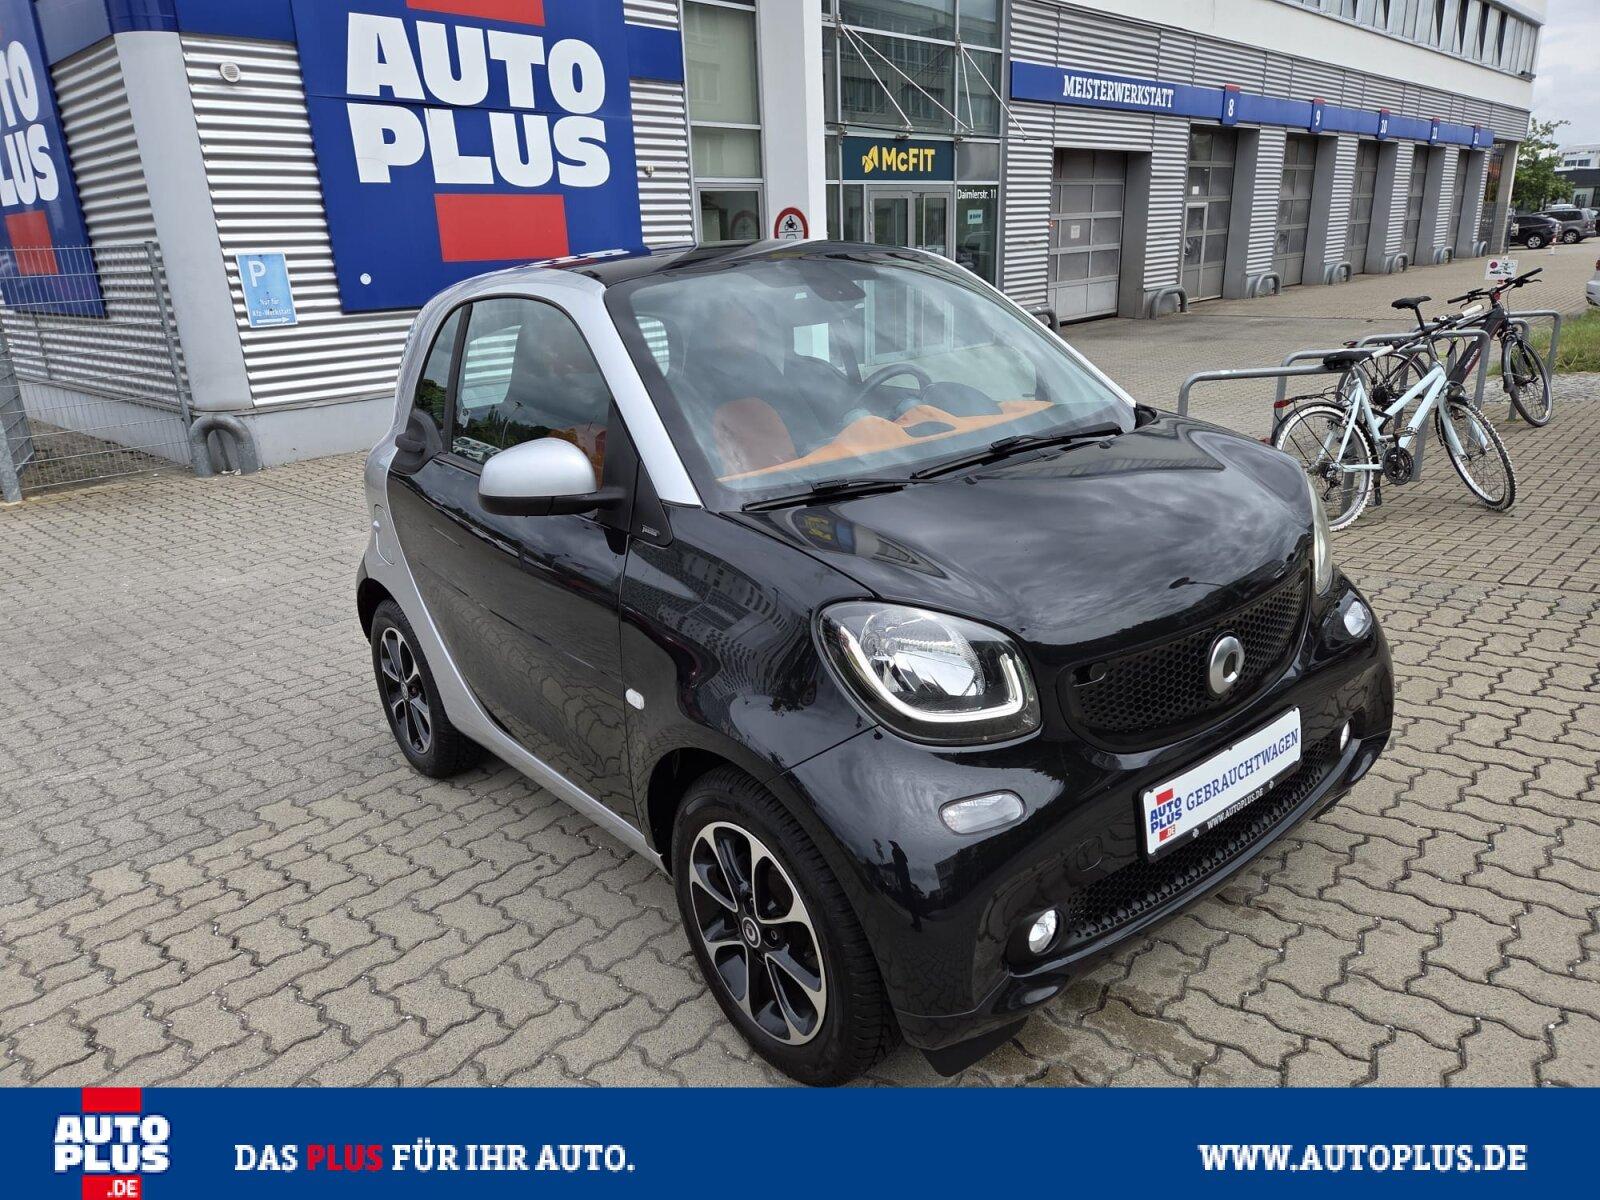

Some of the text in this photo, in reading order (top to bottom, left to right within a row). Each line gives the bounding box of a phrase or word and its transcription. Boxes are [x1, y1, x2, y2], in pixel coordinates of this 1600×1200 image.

[346, 12, 606, 115] AUTO
[1062, 75, 1174, 108] MEISTERWERKSTATT
[1228, 98, 1235, 117] 8
[1315, 110, 1321, 126] 9
[346, 102, 611, 188] PLUS
[881, 147, 936, 172] McFIT
[957, 189, 997, 200] Daimlerstr. 11
[248, 260, 266, 288] P
[1186, 728, 1299, 811] GEBRAUCHTWAGEN
[1150, 796, 1182, 822] AUTO
[1150, 808, 1182, 834] PLUS
[1206, 787, 1264, 830] WWW.AUTOPLUS.DE
